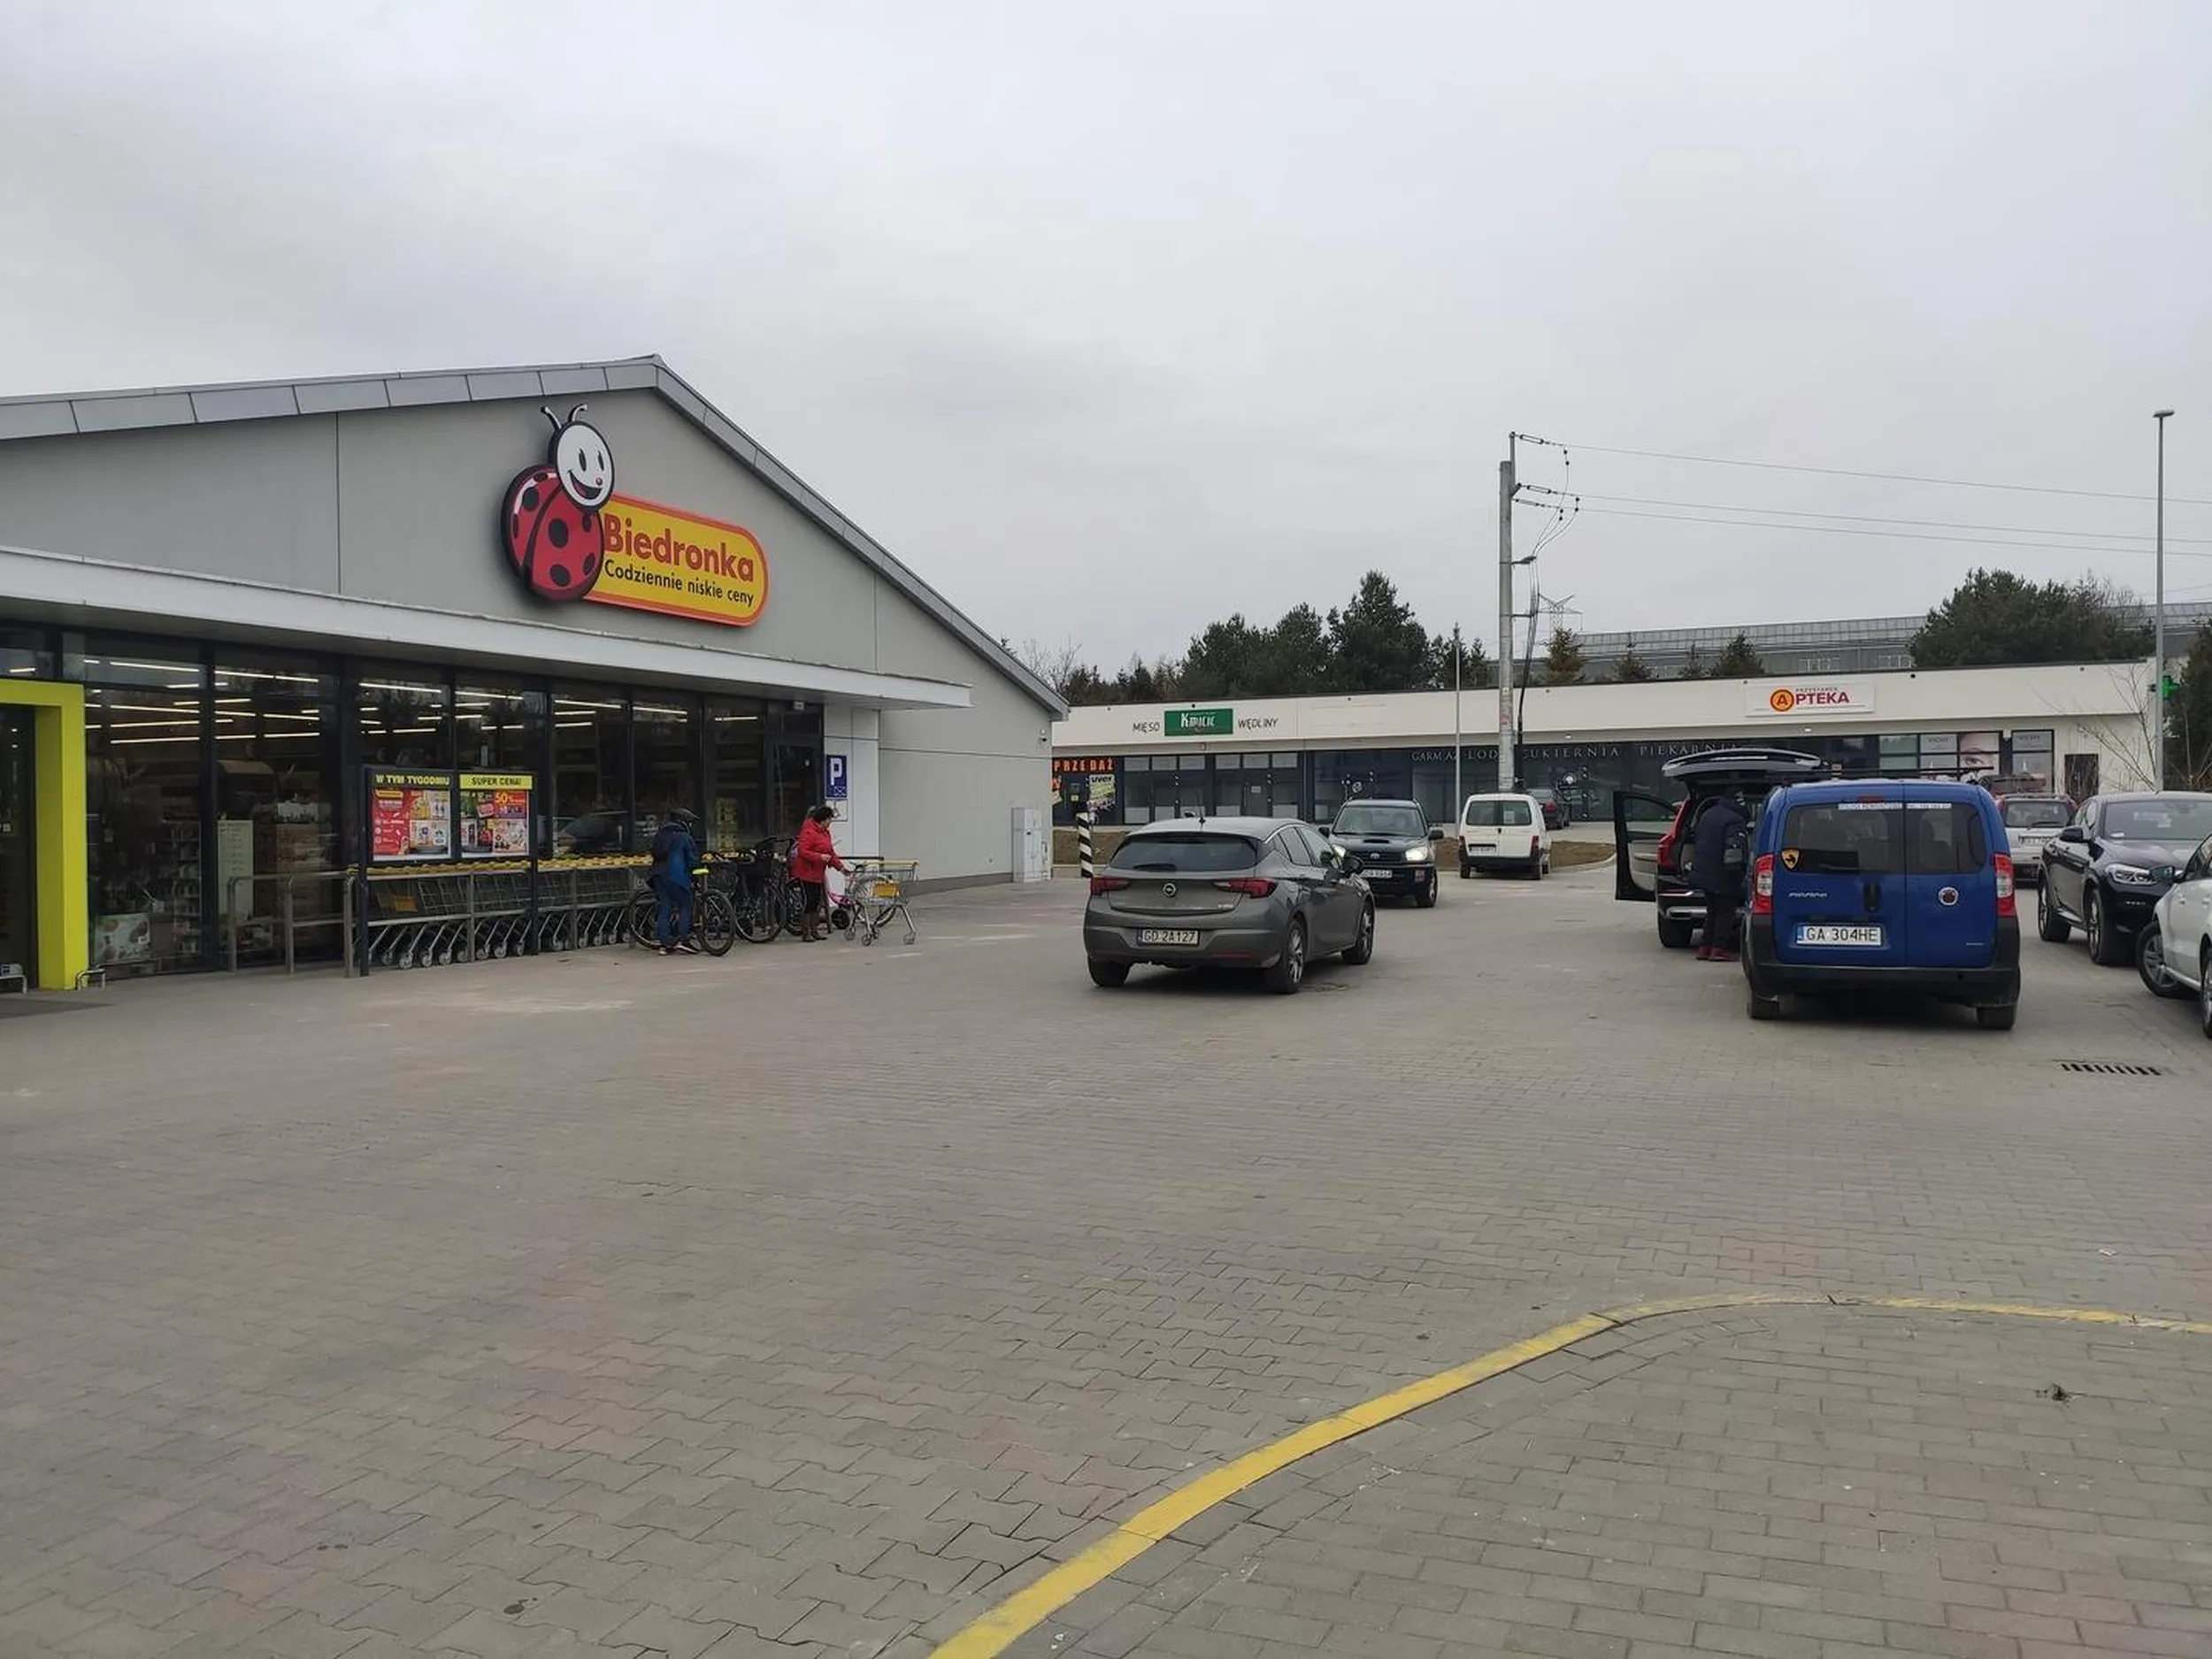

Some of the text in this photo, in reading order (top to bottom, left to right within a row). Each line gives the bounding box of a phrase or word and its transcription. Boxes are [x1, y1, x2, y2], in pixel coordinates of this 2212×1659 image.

[603, 513, 755, 582] Biedronka
[604, 561, 755, 606] Codziennie niskie ceny
[1133, 721, 1160, 733] MIĘSO
[1239, 718, 1279, 730] WĘDLINY
[1468, 749, 1500, 759] LOD
[831, 757, 842, 786] P
[1053, 757, 1113, 772] PRZEDAŻ
[386, 774, 404, 784] TYM
[1807, 927, 1878, 941] GA 304HE
